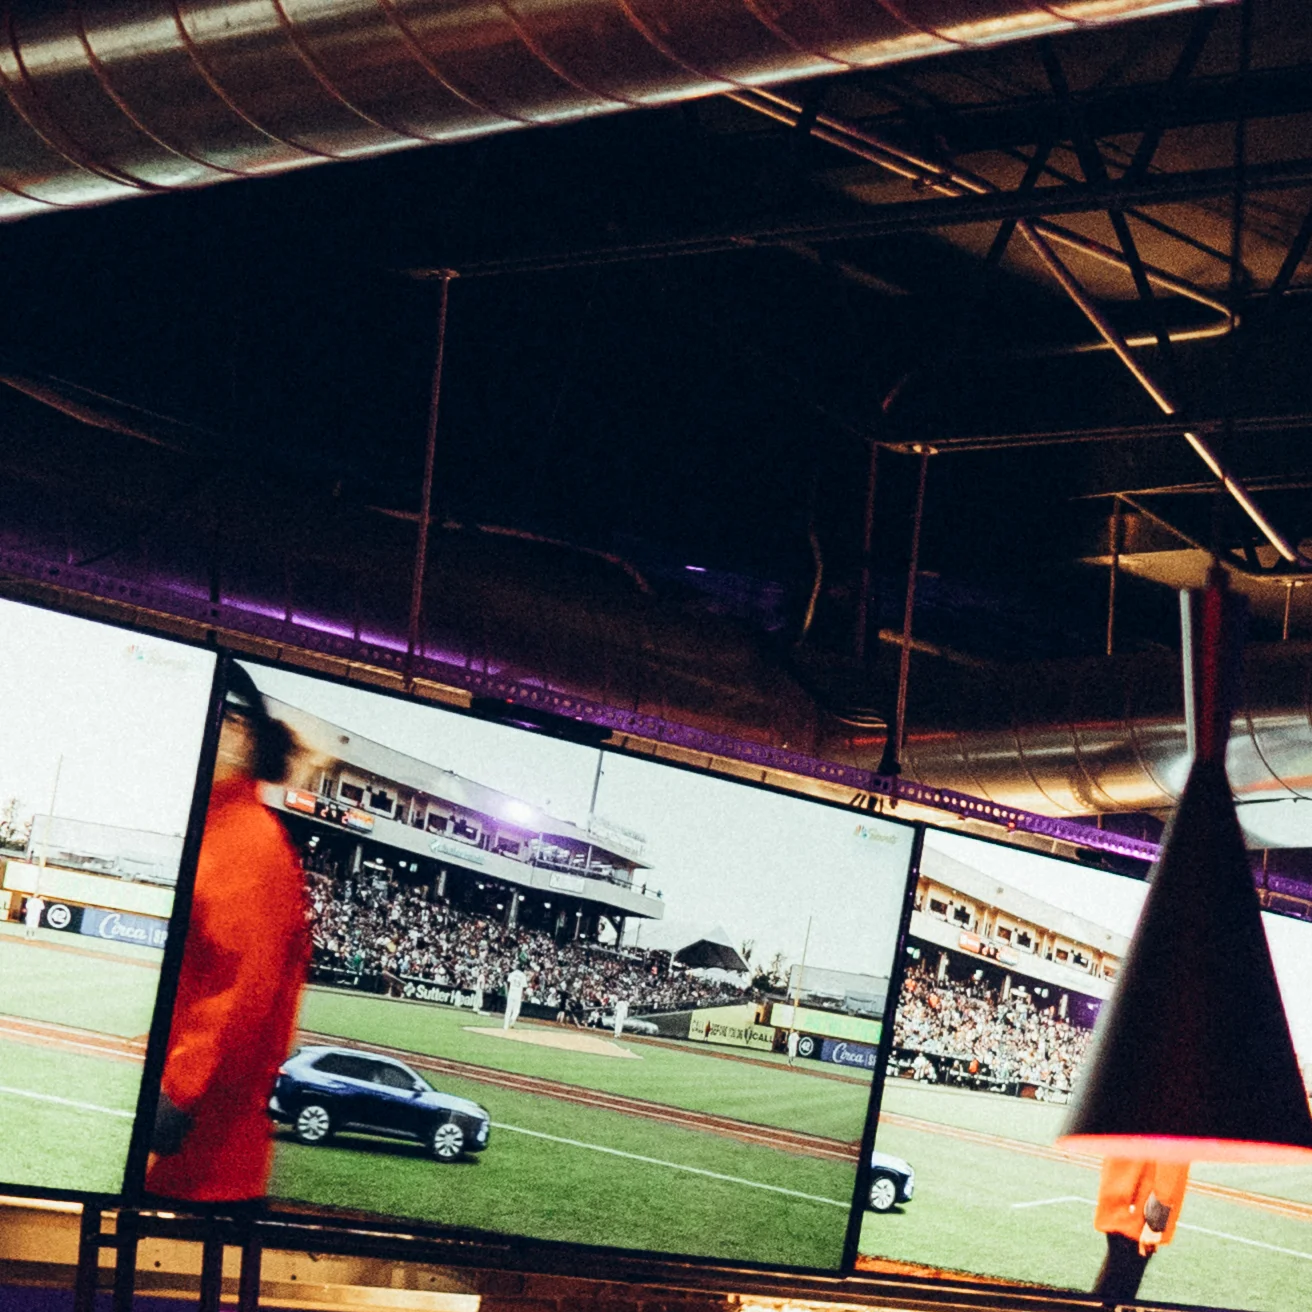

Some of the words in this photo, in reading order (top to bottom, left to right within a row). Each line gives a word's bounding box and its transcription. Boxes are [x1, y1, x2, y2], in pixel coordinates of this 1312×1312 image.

[99, 913, 147, 939] Circa
[416, 984, 450, 1003] Sutter
[832, 1042, 864, 1063] Circa
